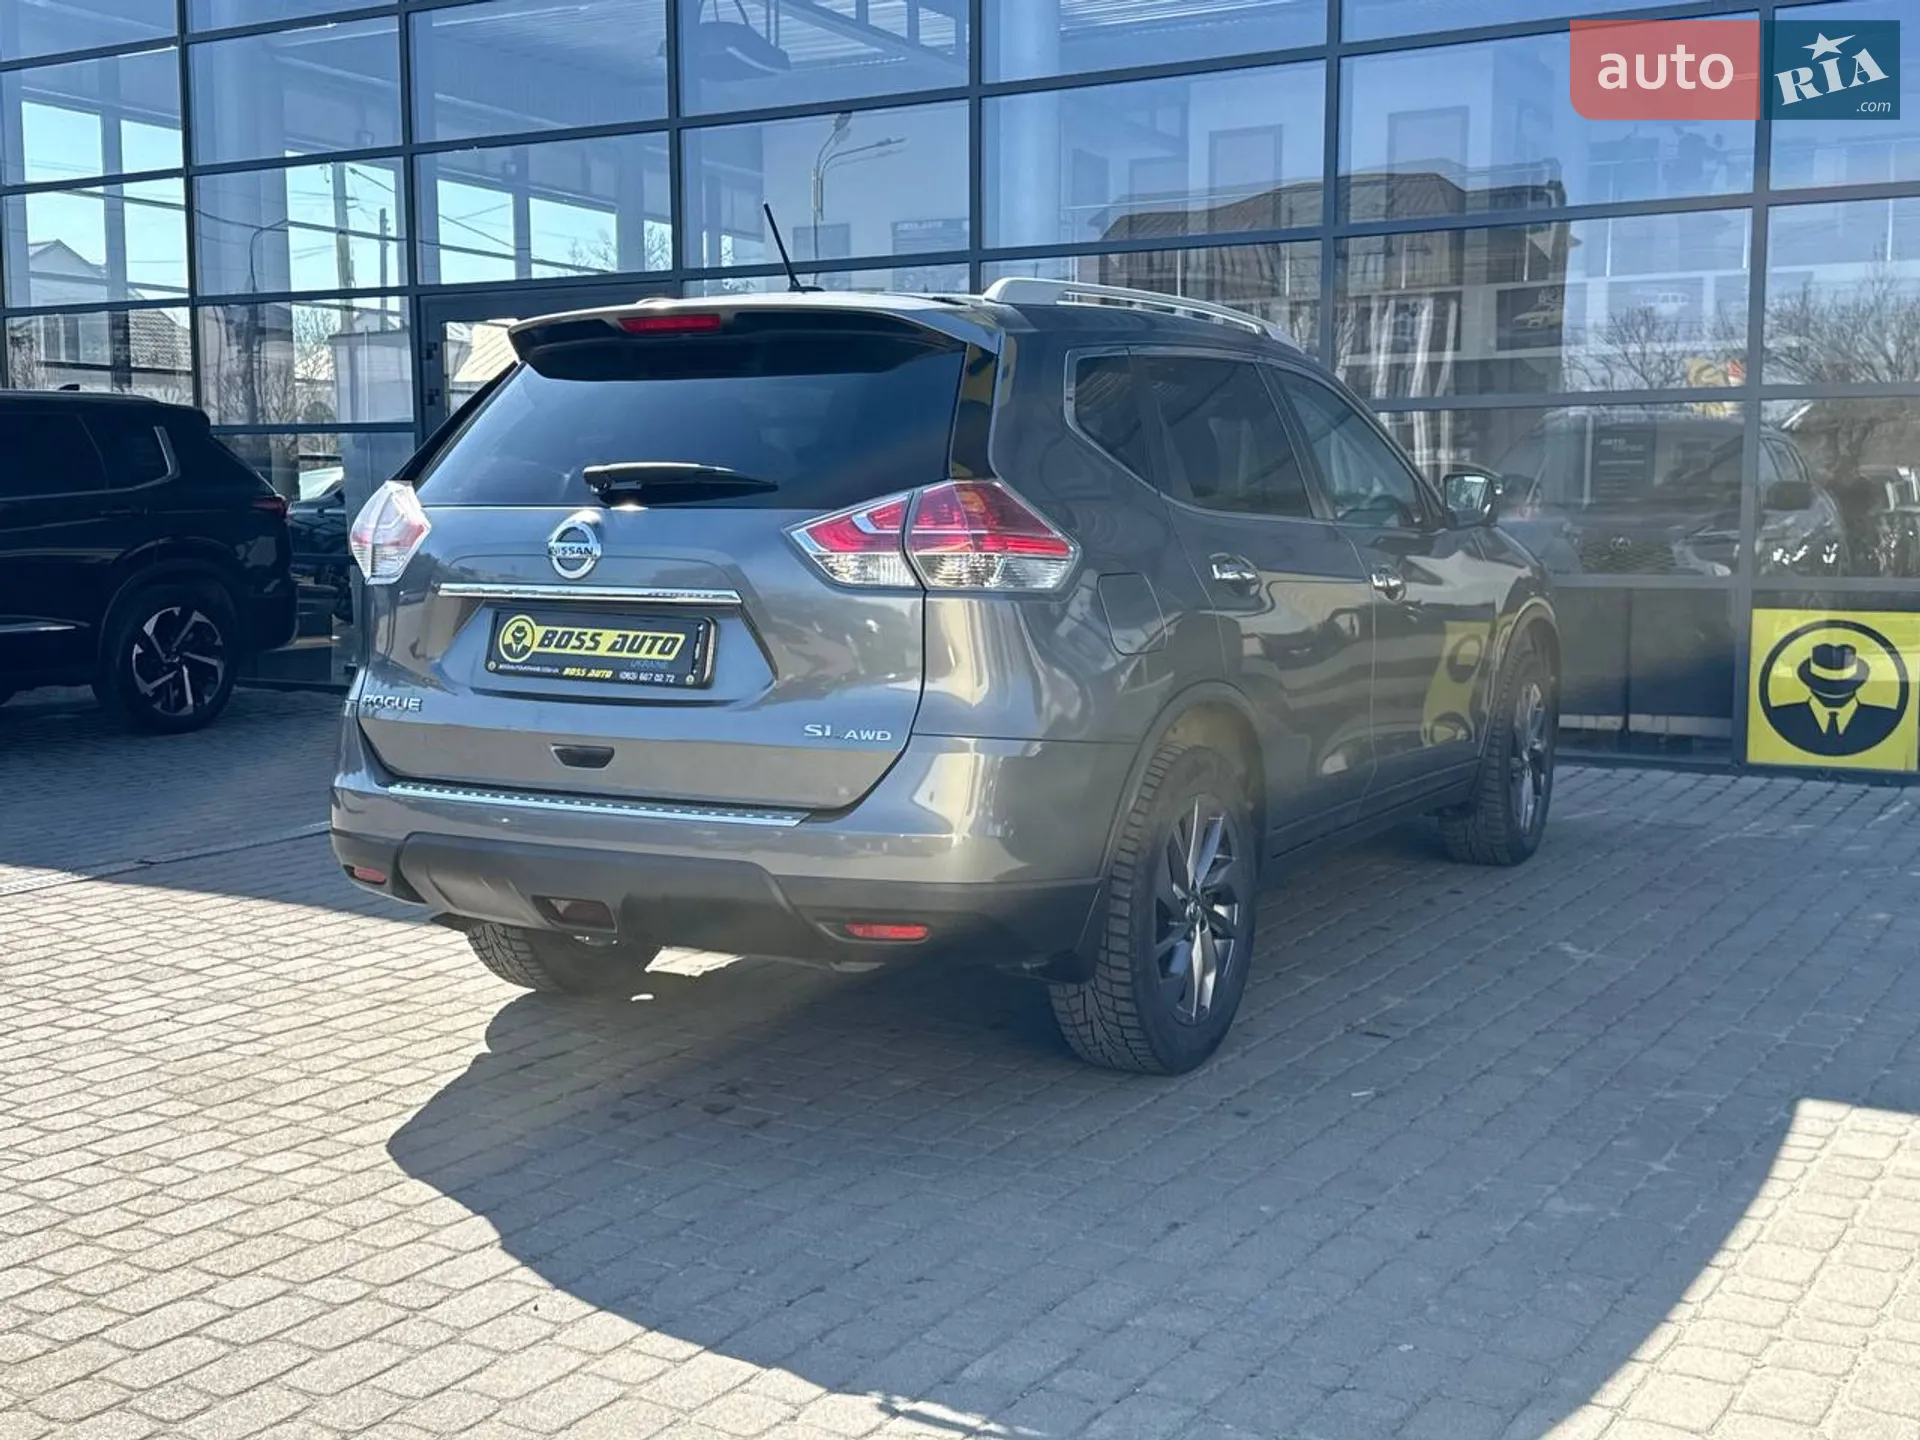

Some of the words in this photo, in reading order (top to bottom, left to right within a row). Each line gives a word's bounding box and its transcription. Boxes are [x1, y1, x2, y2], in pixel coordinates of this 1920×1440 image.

[548, 545, 593, 556] NISSAN
[537, 629, 603, 652] BOSS
[605, 633, 681, 656] AUTO
[562, 667, 586, 678] BOSS
[586, 669, 613, 679] AUTO
[361, 694, 423, 711] ROGUE
[844, 729, 893, 741] AWD
